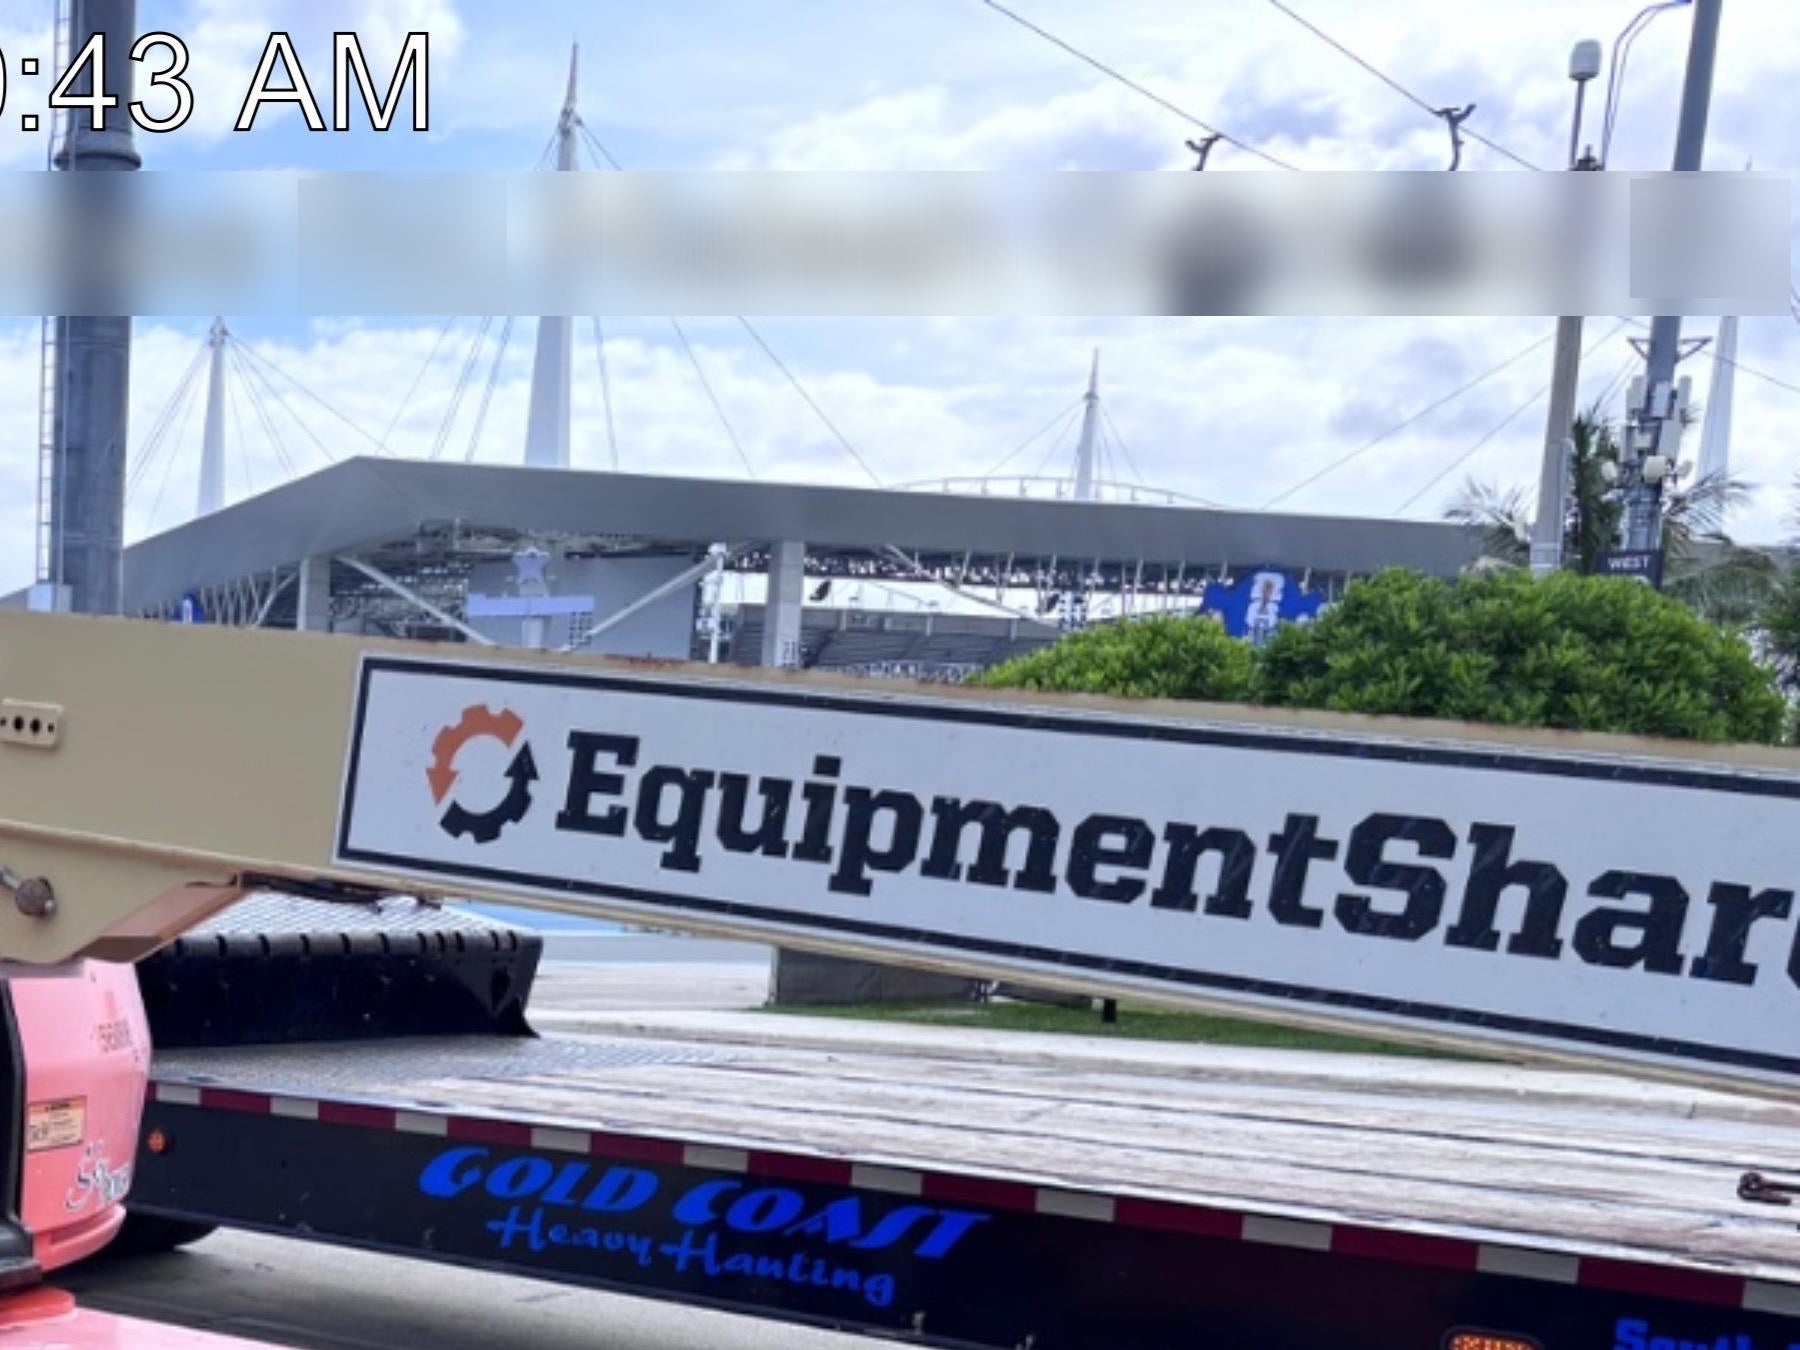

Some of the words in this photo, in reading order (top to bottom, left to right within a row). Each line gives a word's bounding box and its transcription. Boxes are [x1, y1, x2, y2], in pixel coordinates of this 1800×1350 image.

[555, 729, 1800, 990] EquipmentShar
[418, 1146, 659, 1212] GOLD
[671, 1178, 991, 1259] COAST
[487, 1205, 652, 1267] Heavy
[660, 1229, 897, 1307] Hauling
